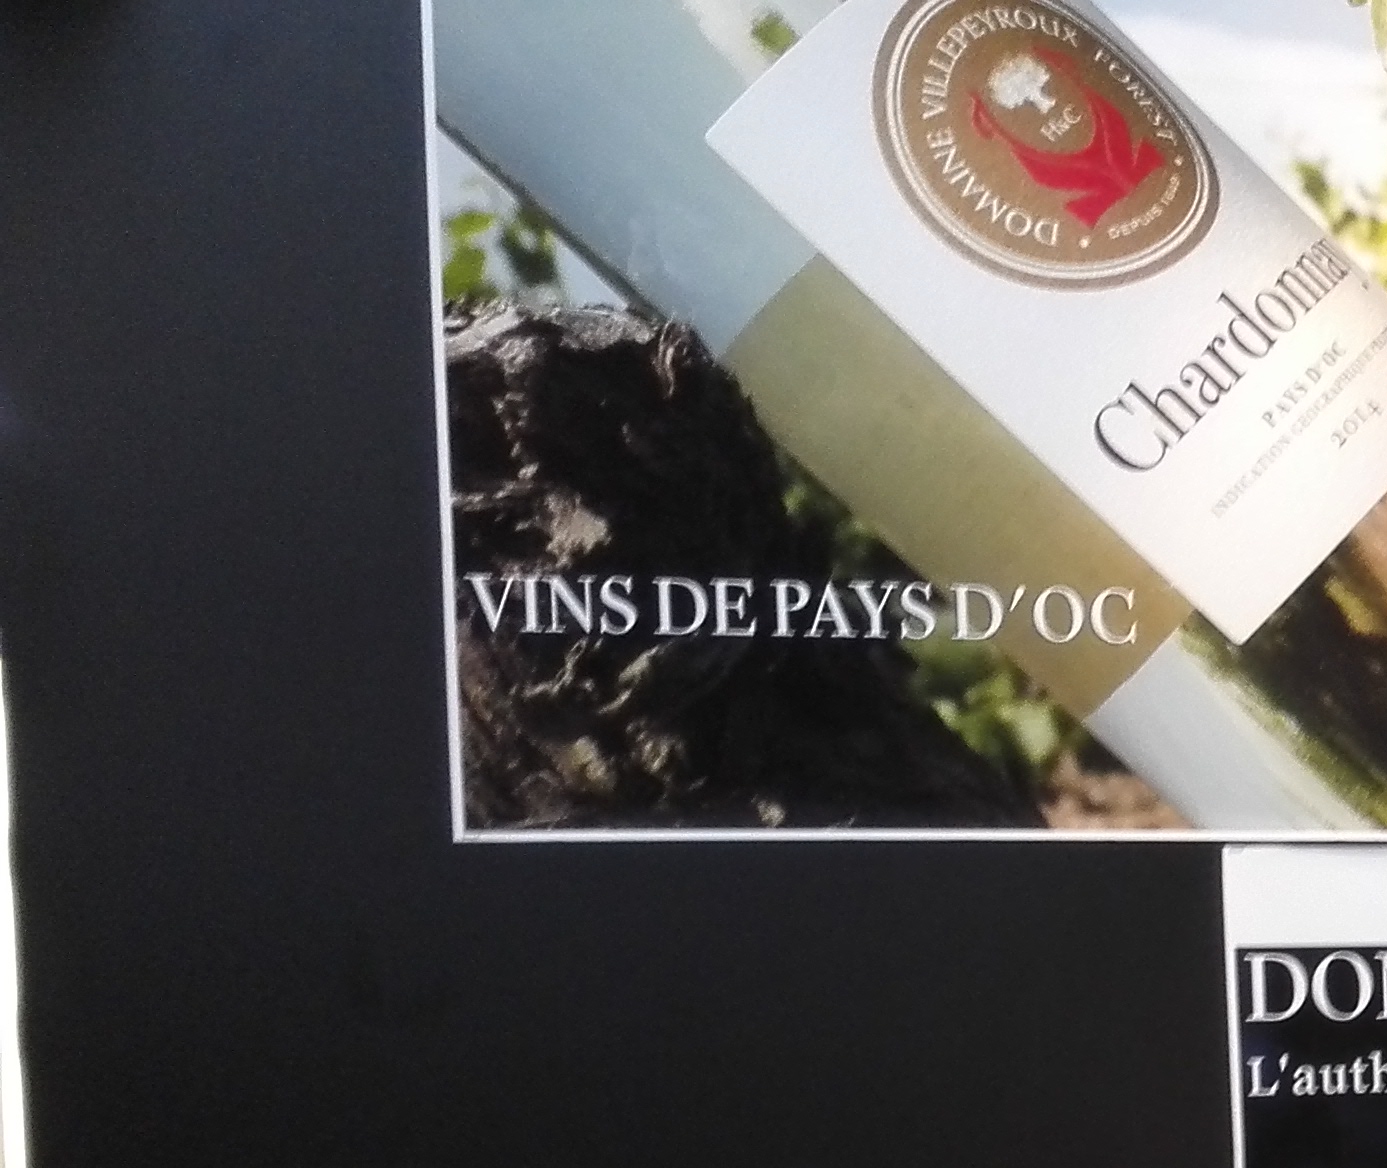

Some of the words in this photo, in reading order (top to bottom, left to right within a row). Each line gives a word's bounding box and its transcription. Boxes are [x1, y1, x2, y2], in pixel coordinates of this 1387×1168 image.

[919, 6, 1079, 121] VILLEPEYROUX
[926, 126, 1060, 248] DOMAINE
[1093, 238, 1369, 473] Chardonna
[1261, 381, 1309, 428] PAYS
[1330, 399, 1384, 449] 2014
[463, 571, 639, 636] VINS
[653, 576, 758, 638] DE
[770, 577, 936, 641] PAYS
[950, 582, 1139, 645] D'OC
